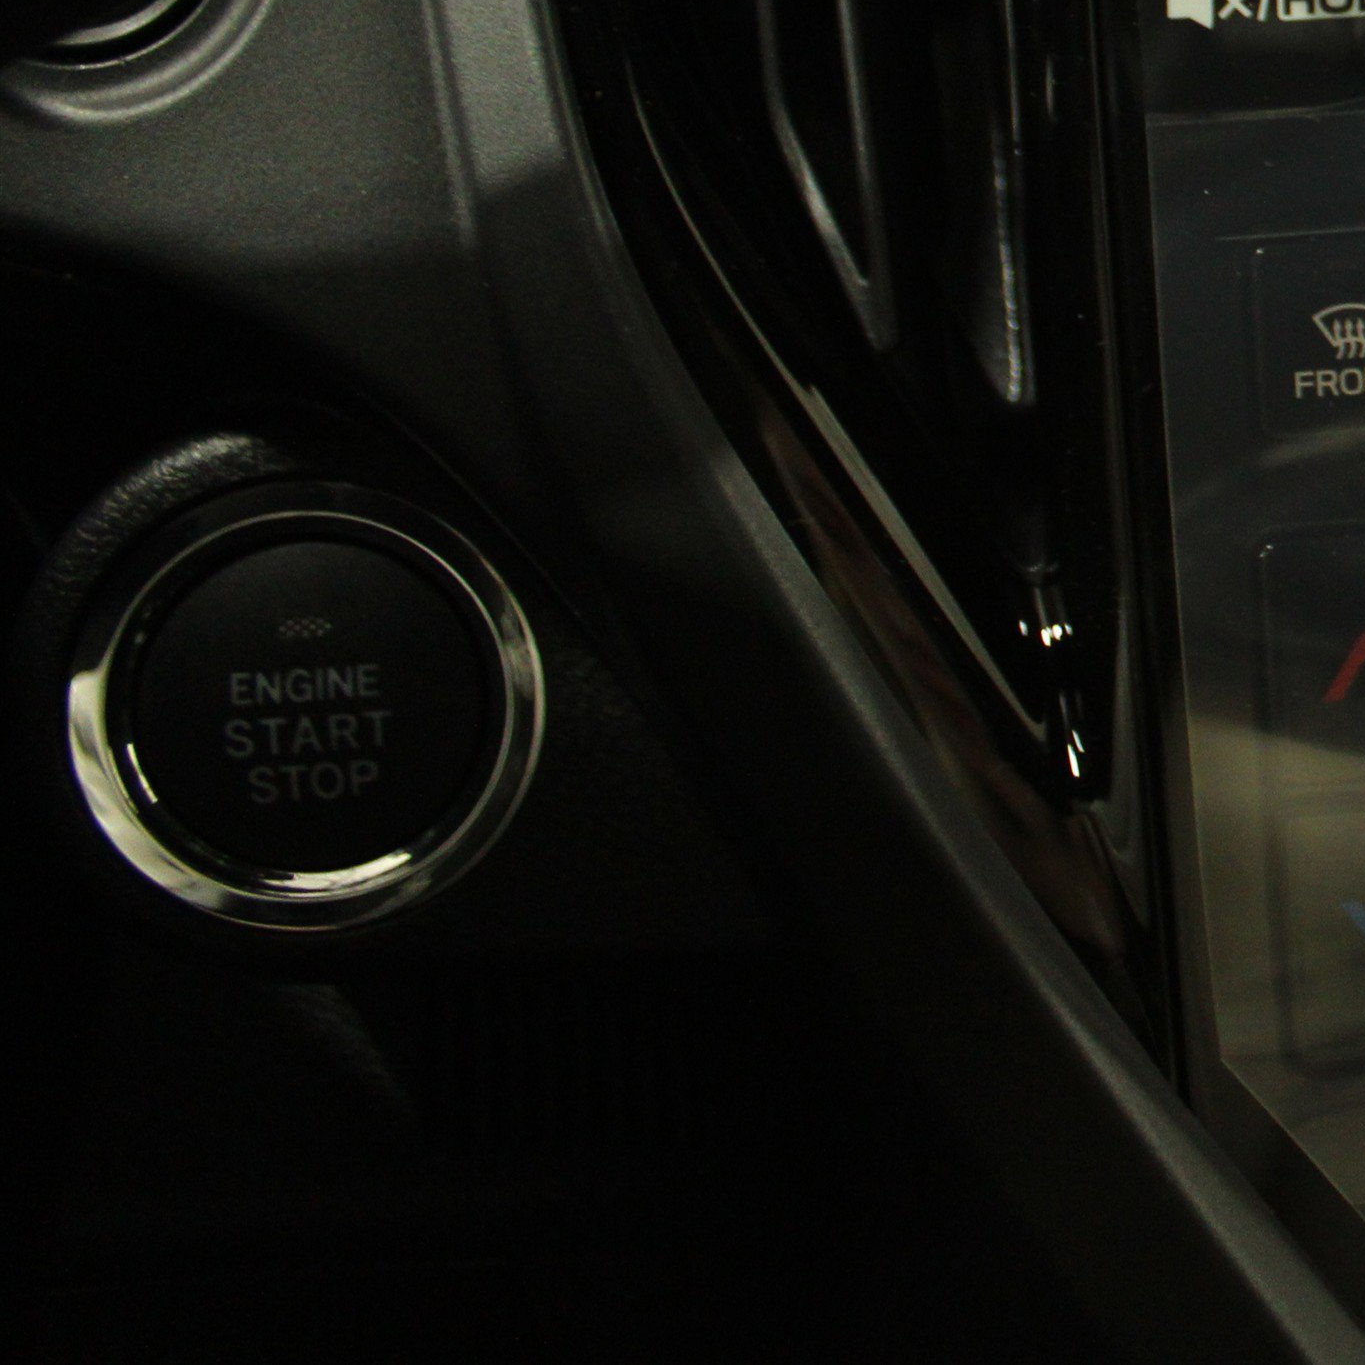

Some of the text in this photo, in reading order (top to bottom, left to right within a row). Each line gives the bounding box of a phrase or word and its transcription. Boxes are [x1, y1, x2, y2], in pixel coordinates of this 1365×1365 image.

[229, 664, 381, 705] ENGINE
[223, 711, 392, 759] START
[248, 760, 380, 805] STOP
